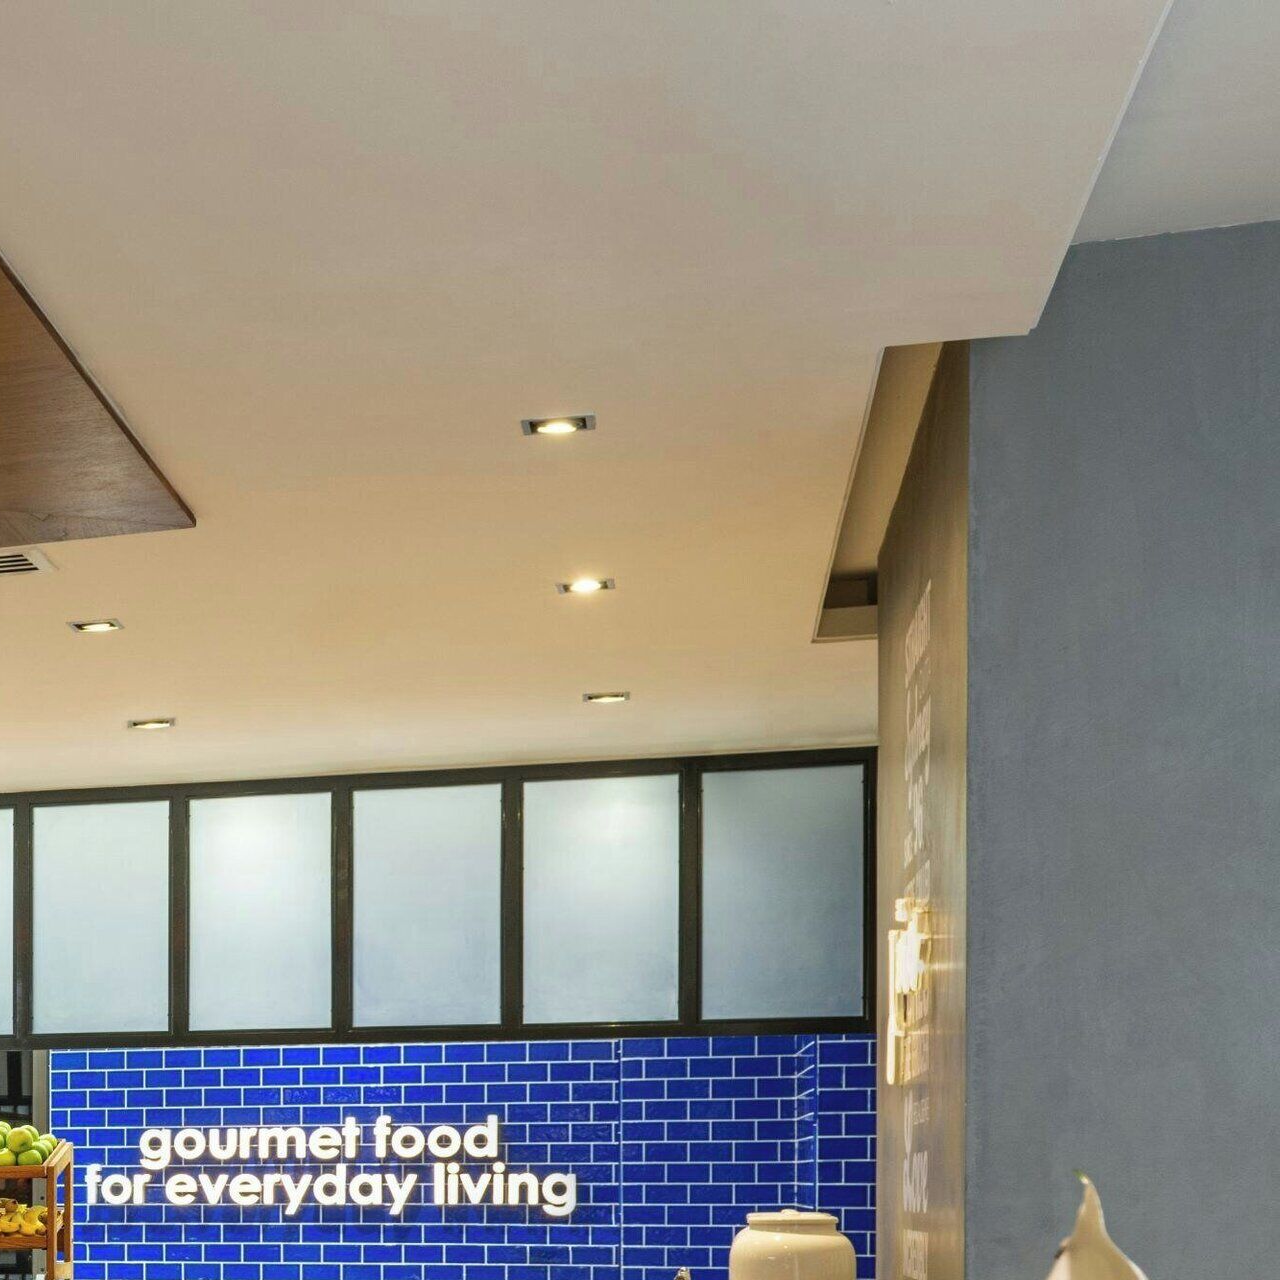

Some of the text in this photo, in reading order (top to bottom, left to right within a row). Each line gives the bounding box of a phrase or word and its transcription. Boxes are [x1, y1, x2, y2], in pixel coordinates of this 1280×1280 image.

[139, 1114, 500, 1169] gourmet food
[85, 1162, 578, 1217] for everyday living
